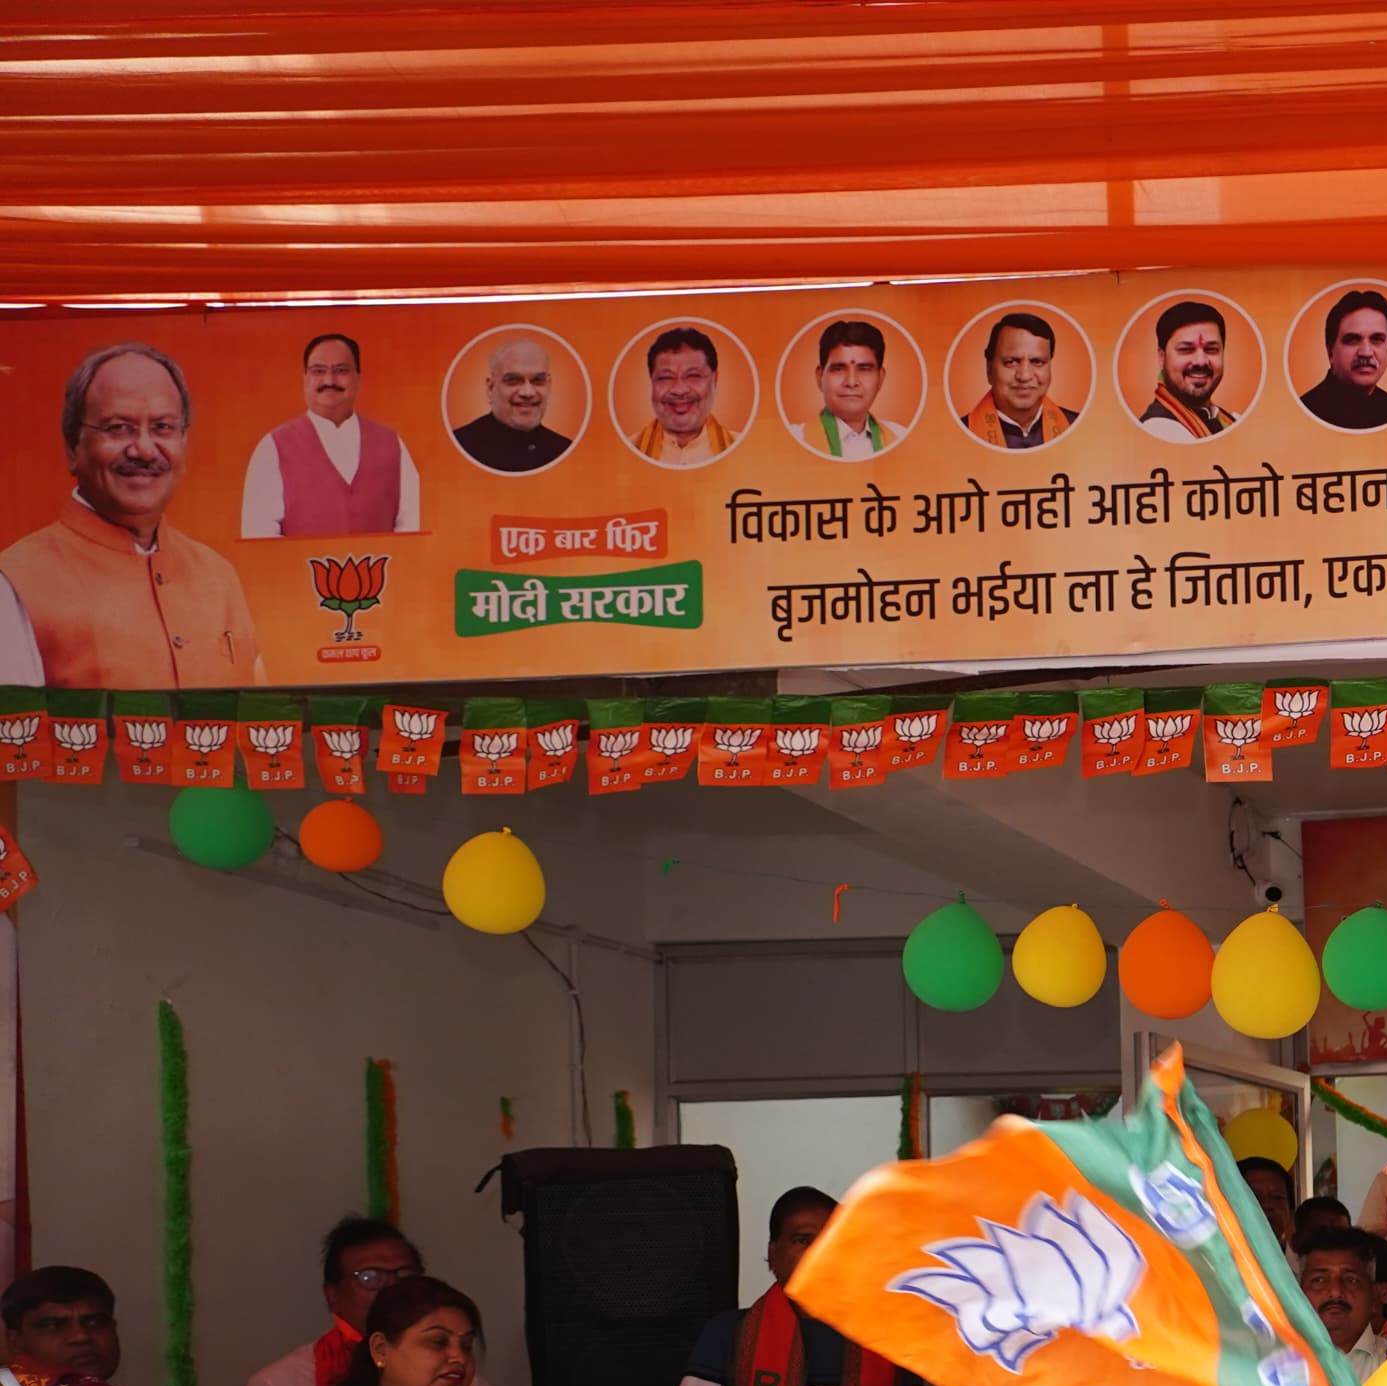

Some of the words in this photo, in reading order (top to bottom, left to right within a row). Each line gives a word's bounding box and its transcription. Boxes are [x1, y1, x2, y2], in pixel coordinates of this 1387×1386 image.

[726, 488, 852, 544] विकास
[860, 482, 900, 538] के
[912, 478, 988, 535] आगे
[997, 473, 1075, 531] नही
[1087, 467, 1174, 526] आही
[1181, 462, 1284, 521] कोनो
[499, 527, 547, 558] एक
[554, 529, 599, 550] बार
[606, 518, 659, 553] फिर
[469, 578, 549, 623] मोदी
[558, 584, 689, 620] सरकार
[767, 568, 941, 642] बृजमोहन
[949, 560, 1056, 622] भईया
[1064, 571, 1118, 614] ला
[1126, 555, 1158, 609] हे
[1163, 551, 1313, 610] जिताना,
[891, 751, 927, 766] B.J.P.
[1019, 752, 1055, 766] B.J.P.
[1096, 755, 1134, 771] B.J.P.
[1146, 753, 1182, 768] B.J.P.
[1346, 751, 1386, 764] B.J.P.
[773, 768, 809, 779] B.J.P.
[958, 761, 998, 773] B.J.P.
[1221, 763, 1262, 775] B.J.P.
[714, 769, 753, 780] B.J.P.
[842, 768, 877, 781] B.J.P.
